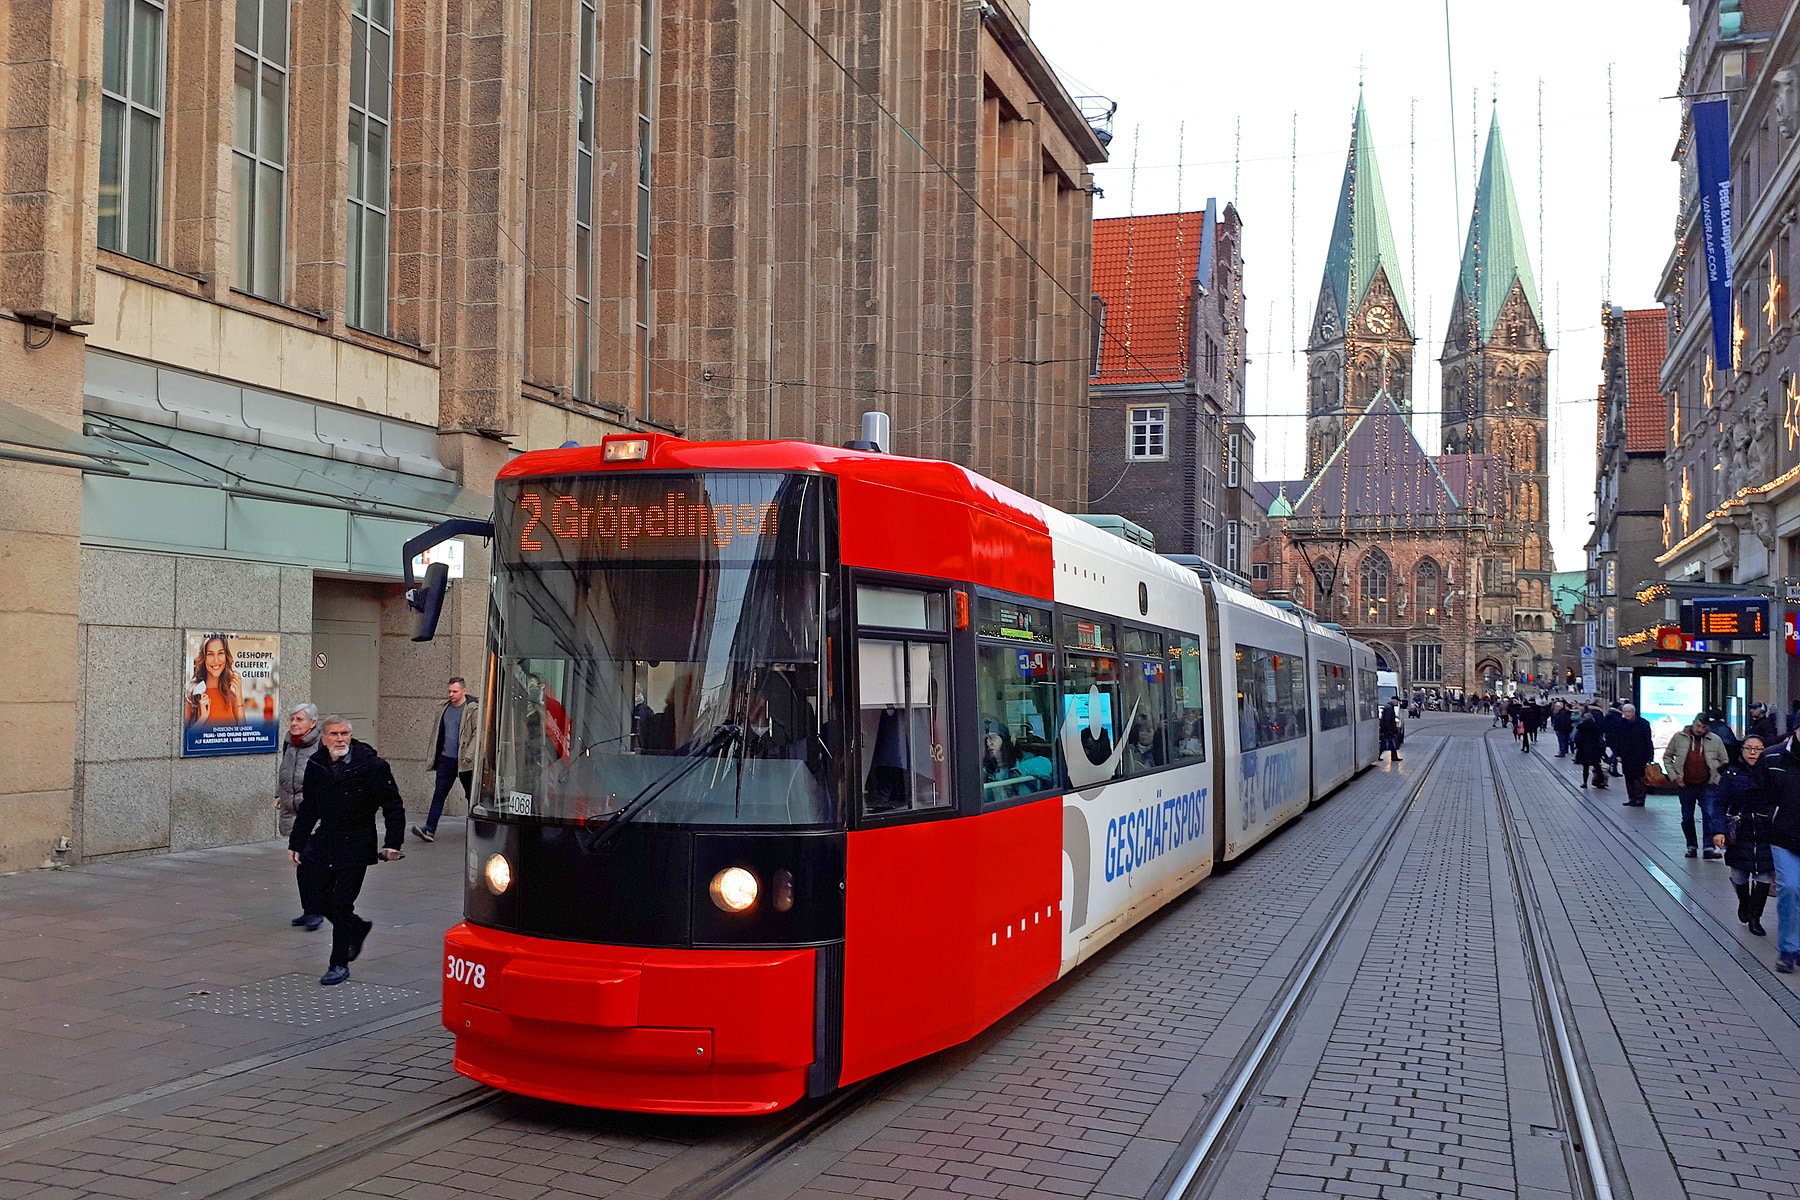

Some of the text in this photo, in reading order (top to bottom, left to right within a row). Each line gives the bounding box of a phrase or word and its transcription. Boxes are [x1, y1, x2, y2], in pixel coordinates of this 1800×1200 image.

[1702, 195, 1718, 282] VANGRAAF.COM
[520, 492, 778, 551] 2 Gröpelingen
[234, 661, 270, 669] GELIEFERT,
[237, 651, 275, 660] GESHOPPT,
[510, 796, 531, 815] 4068
[1105, 788, 1207, 883] GESCHÄFTSPOST
[446, 955, 486, 989] 3078
